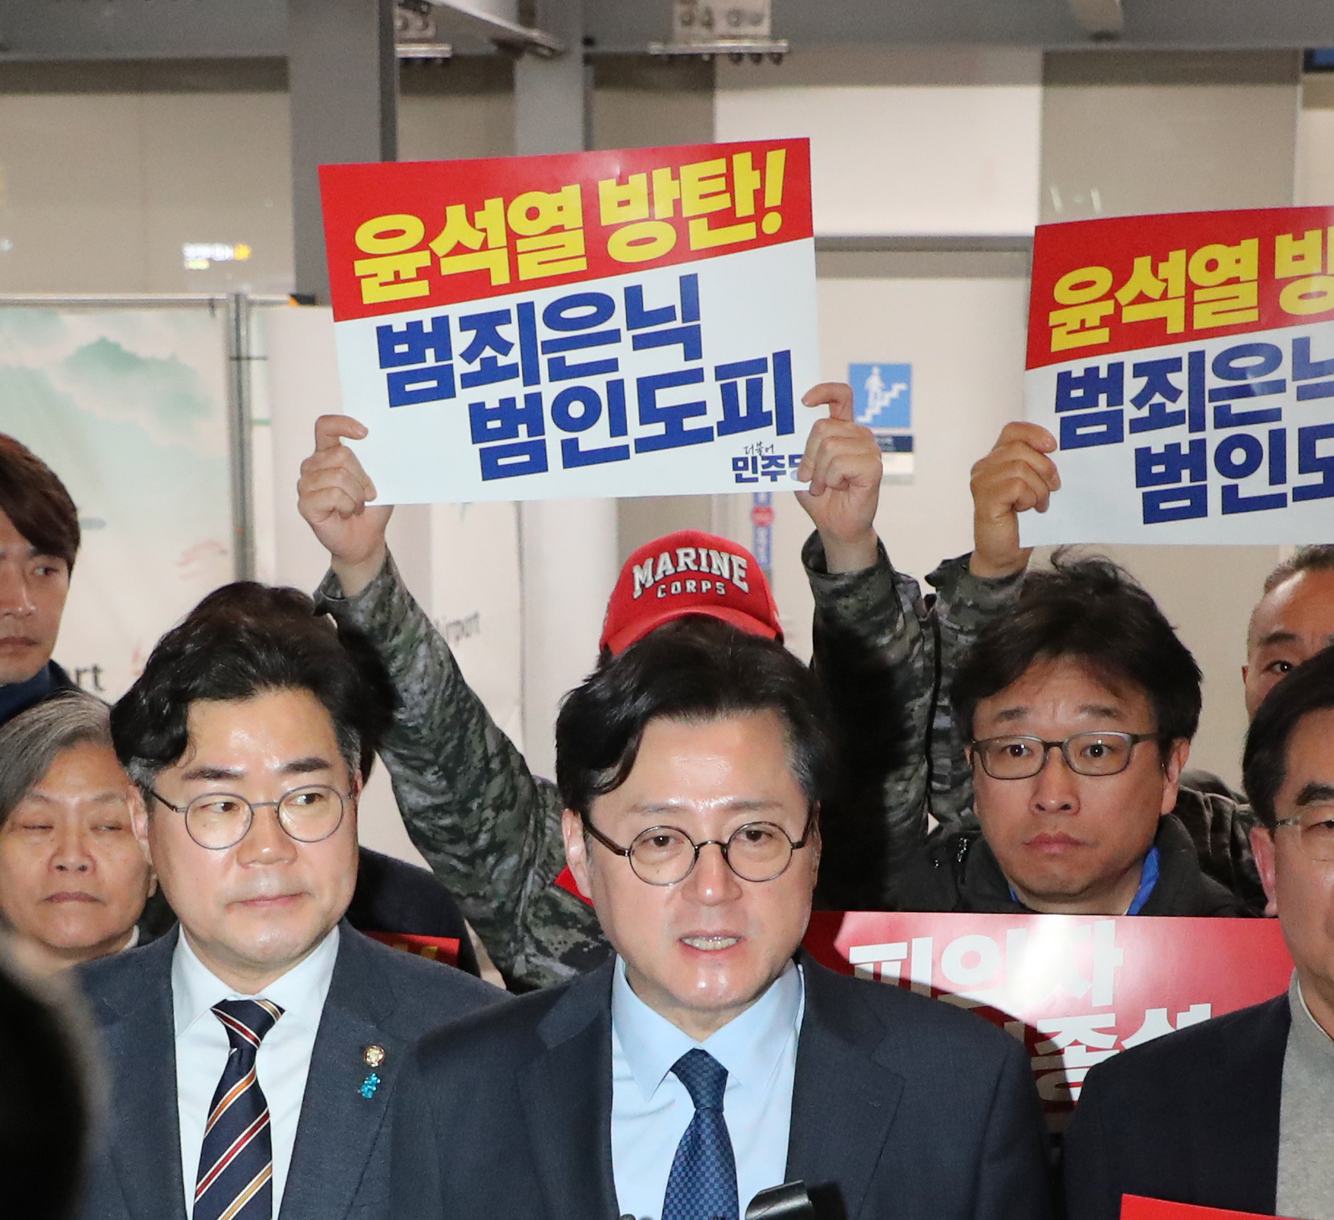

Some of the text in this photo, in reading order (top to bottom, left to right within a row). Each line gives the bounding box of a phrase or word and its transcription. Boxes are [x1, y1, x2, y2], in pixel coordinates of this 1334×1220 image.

[353, 149, 786, 304] 윤석열 방탄!
[376, 273, 702, 408] 범죄은닉
[1049, 238, 1259, 352] 윤석열
[468, 350, 795, 481] 범인도피
[632, 547, 749, 600] MARINE
[657, 579, 726, 599] CORPS
